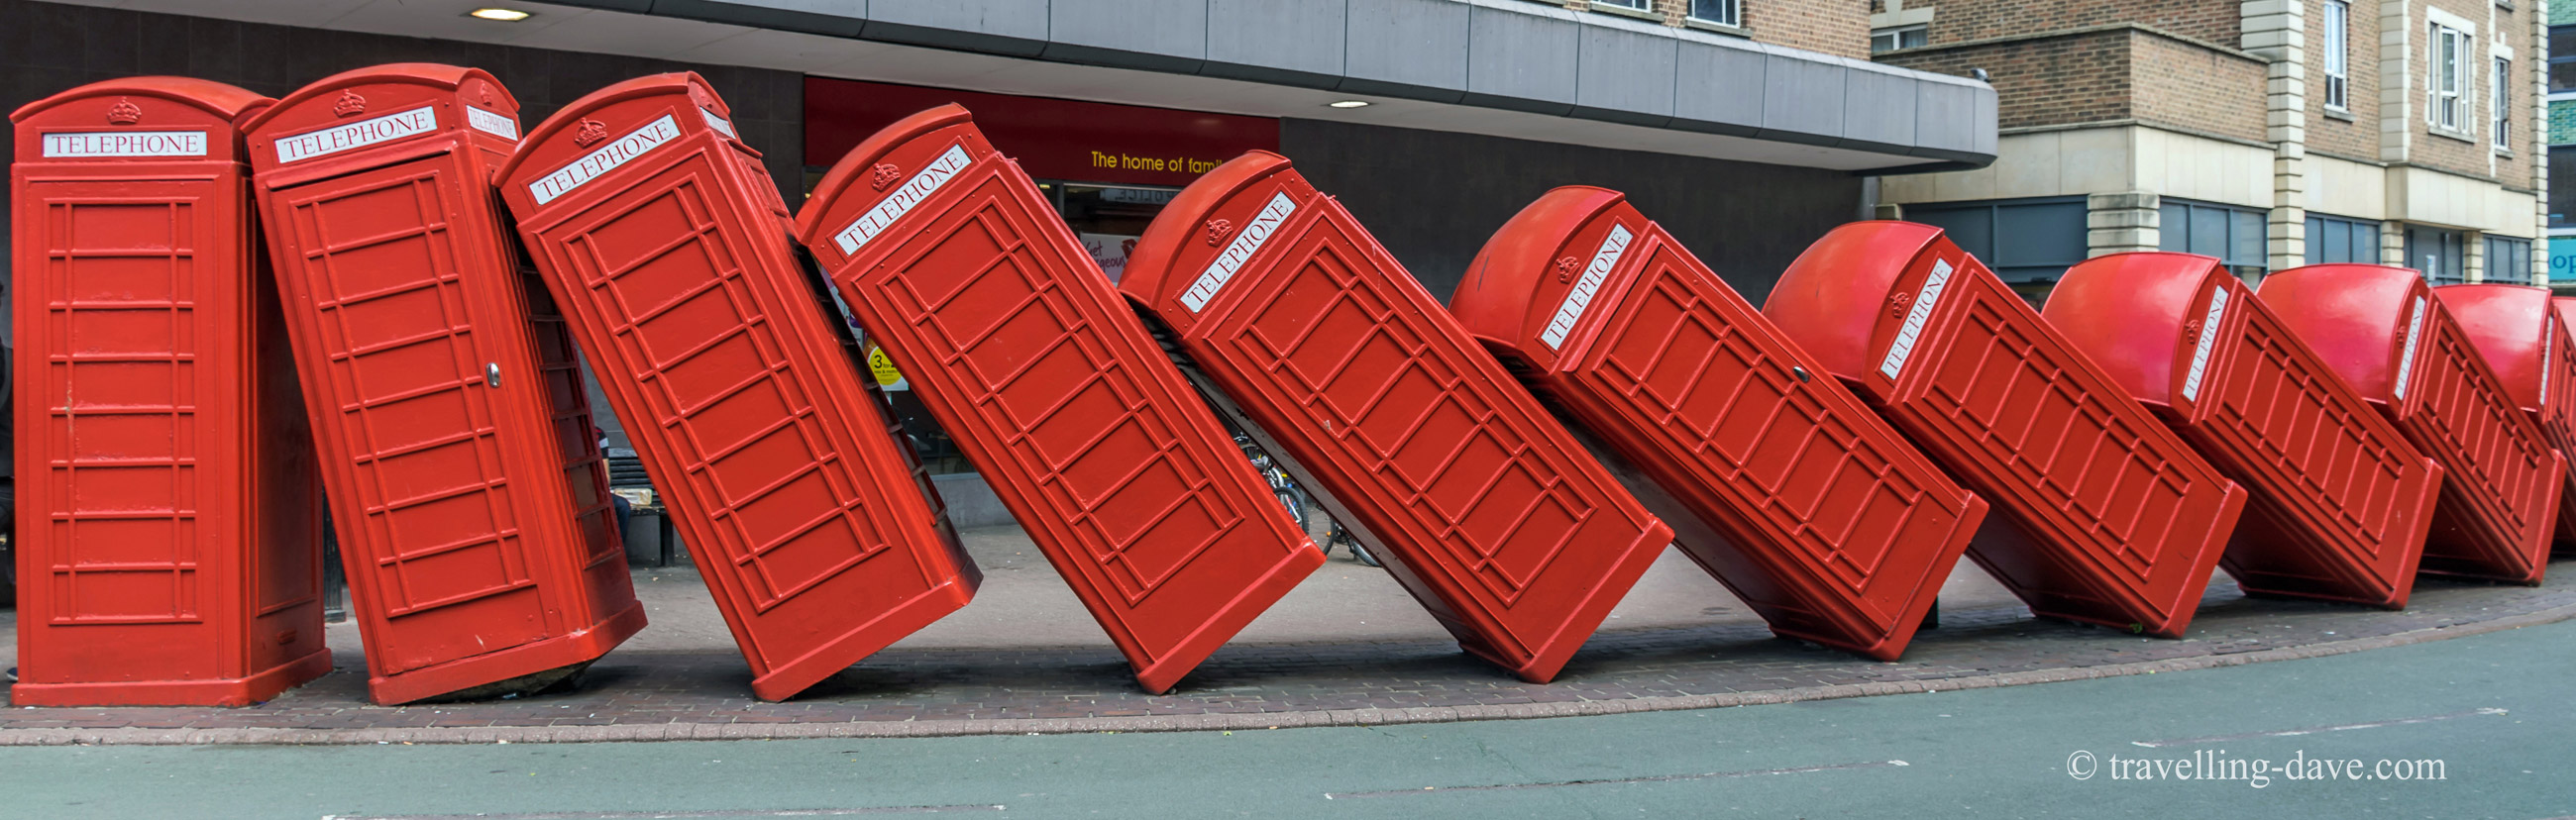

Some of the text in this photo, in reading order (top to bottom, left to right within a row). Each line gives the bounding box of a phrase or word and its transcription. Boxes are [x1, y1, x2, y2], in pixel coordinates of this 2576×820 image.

[52, 136, 198, 154] TELEPHONE
[283, 112, 429, 158] TELEPHONE
[469, 109, 514, 137] TELEPHONE
[538, 122, 673, 198] TELEPHONE
[1091, 151, 1118, 168] The
[1122, 153, 1164, 171] home
[1168, 156, 1184, 172] of
[844, 152, 963, 248] TELEPHONE
[1187, 199, 1289, 304] TELEPHONE
[1548, 231, 1627, 340] TELEPHONE
[1885, 264, 1947, 371] TELEPHONE
[2187, 292, 2225, 392] TELEPHONE
[874, 355, 882, 368] 3
